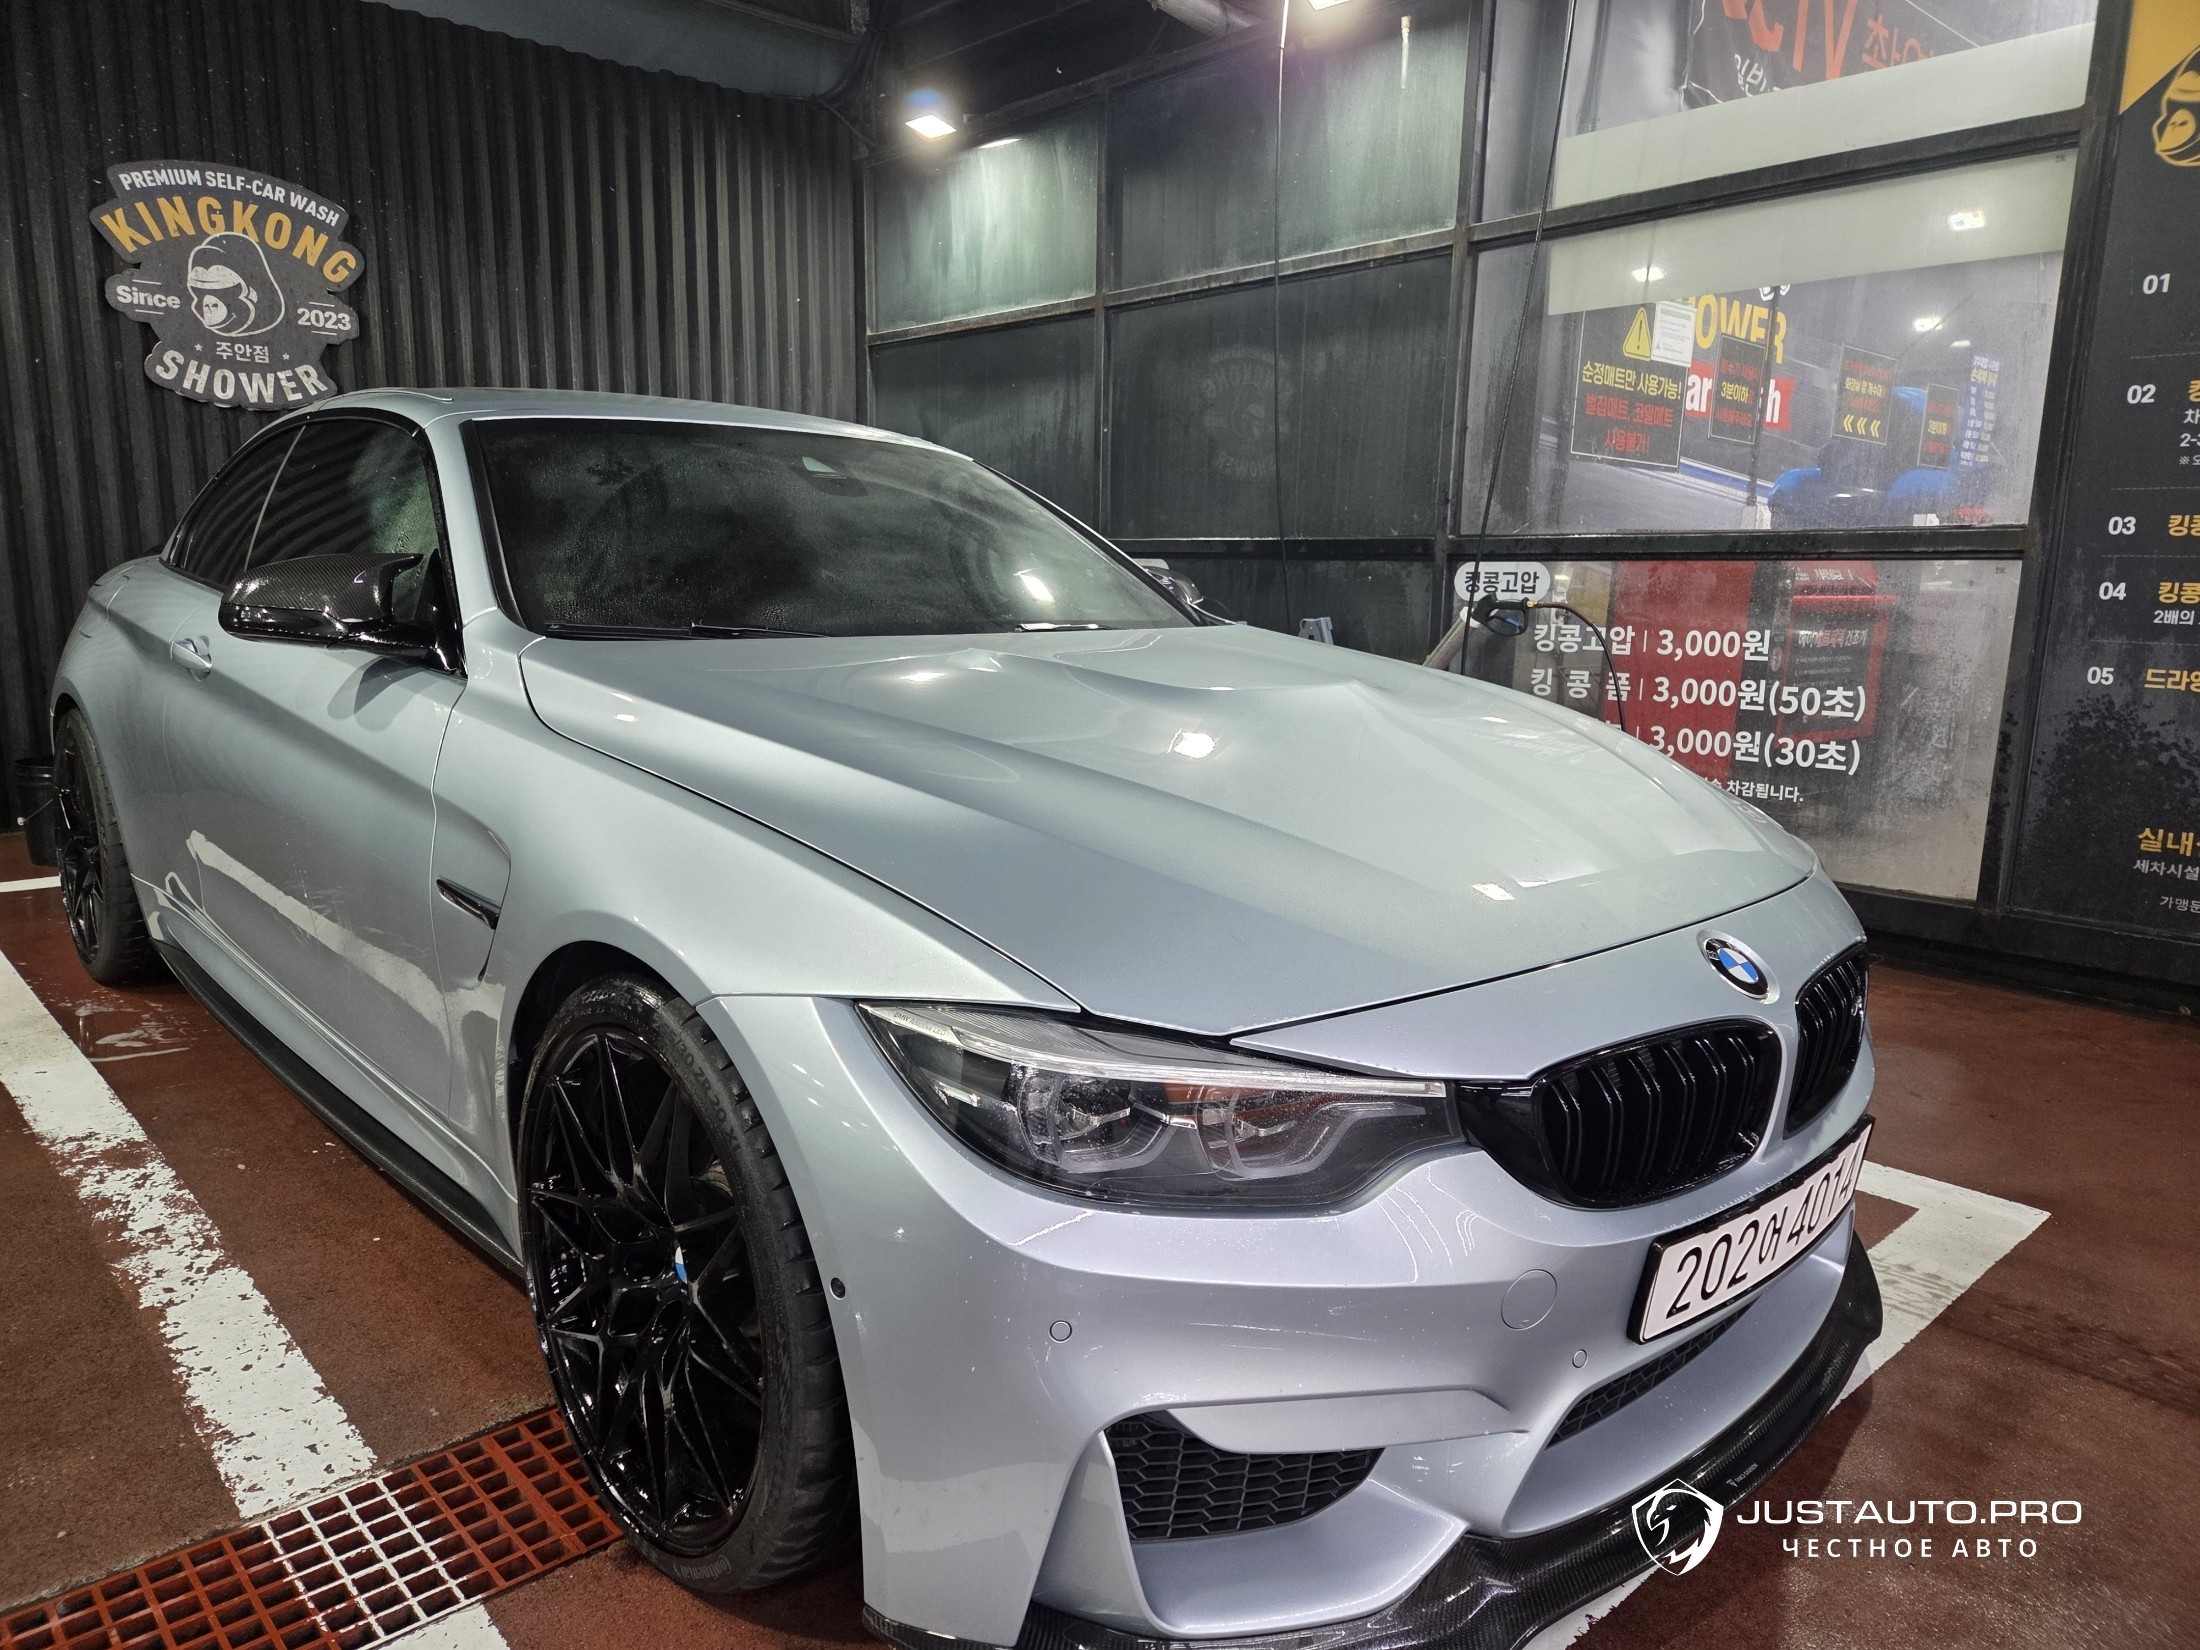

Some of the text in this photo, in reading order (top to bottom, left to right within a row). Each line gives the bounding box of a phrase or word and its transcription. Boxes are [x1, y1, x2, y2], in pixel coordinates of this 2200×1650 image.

[119, 169, 340, 227] PREMIUM SELF-CAR WASH
[100, 196, 357, 283] KINGKONG
[2142, 273, 2171, 295] 01
[116, 286, 180, 309] Since
[297, 308, 351, 331] 2023
[216, 341, 270, 364] 주안점
[155, 350, 329, 404] SHOWER
[1582, 360, 1682, 400] 순정매트만 사용가능!
[2127, 383, 2156, 404] 02
[2108, 516, 2136, 535] 03
[1465, 571, 1539, 595] 킹콩고압
[2099, 581, 2127, 600] 04
[2153, 610, 2196, 626] 2배의
[1534, 624, 1771, 662] 킹콩고압 3,000원
[2087, 666, 2114, 685] 05
[1531, 668, 1553, 696] 킹
[1566, 670, 1592, 699] 콩
[1652, 676, 1867, 723] 3,000원(50초)
[1650, 725, 1861, 776] 3,000원(30초)
[1726, 779, 1804, 803] 차감됩니다.
[2138, 827, 2200, 857] 실내
[893, 1011, 911, 1023] BMW
[932, 1027, 948, 1037] LED
[1665, 1139, 1862, 1320] 202어 4014
